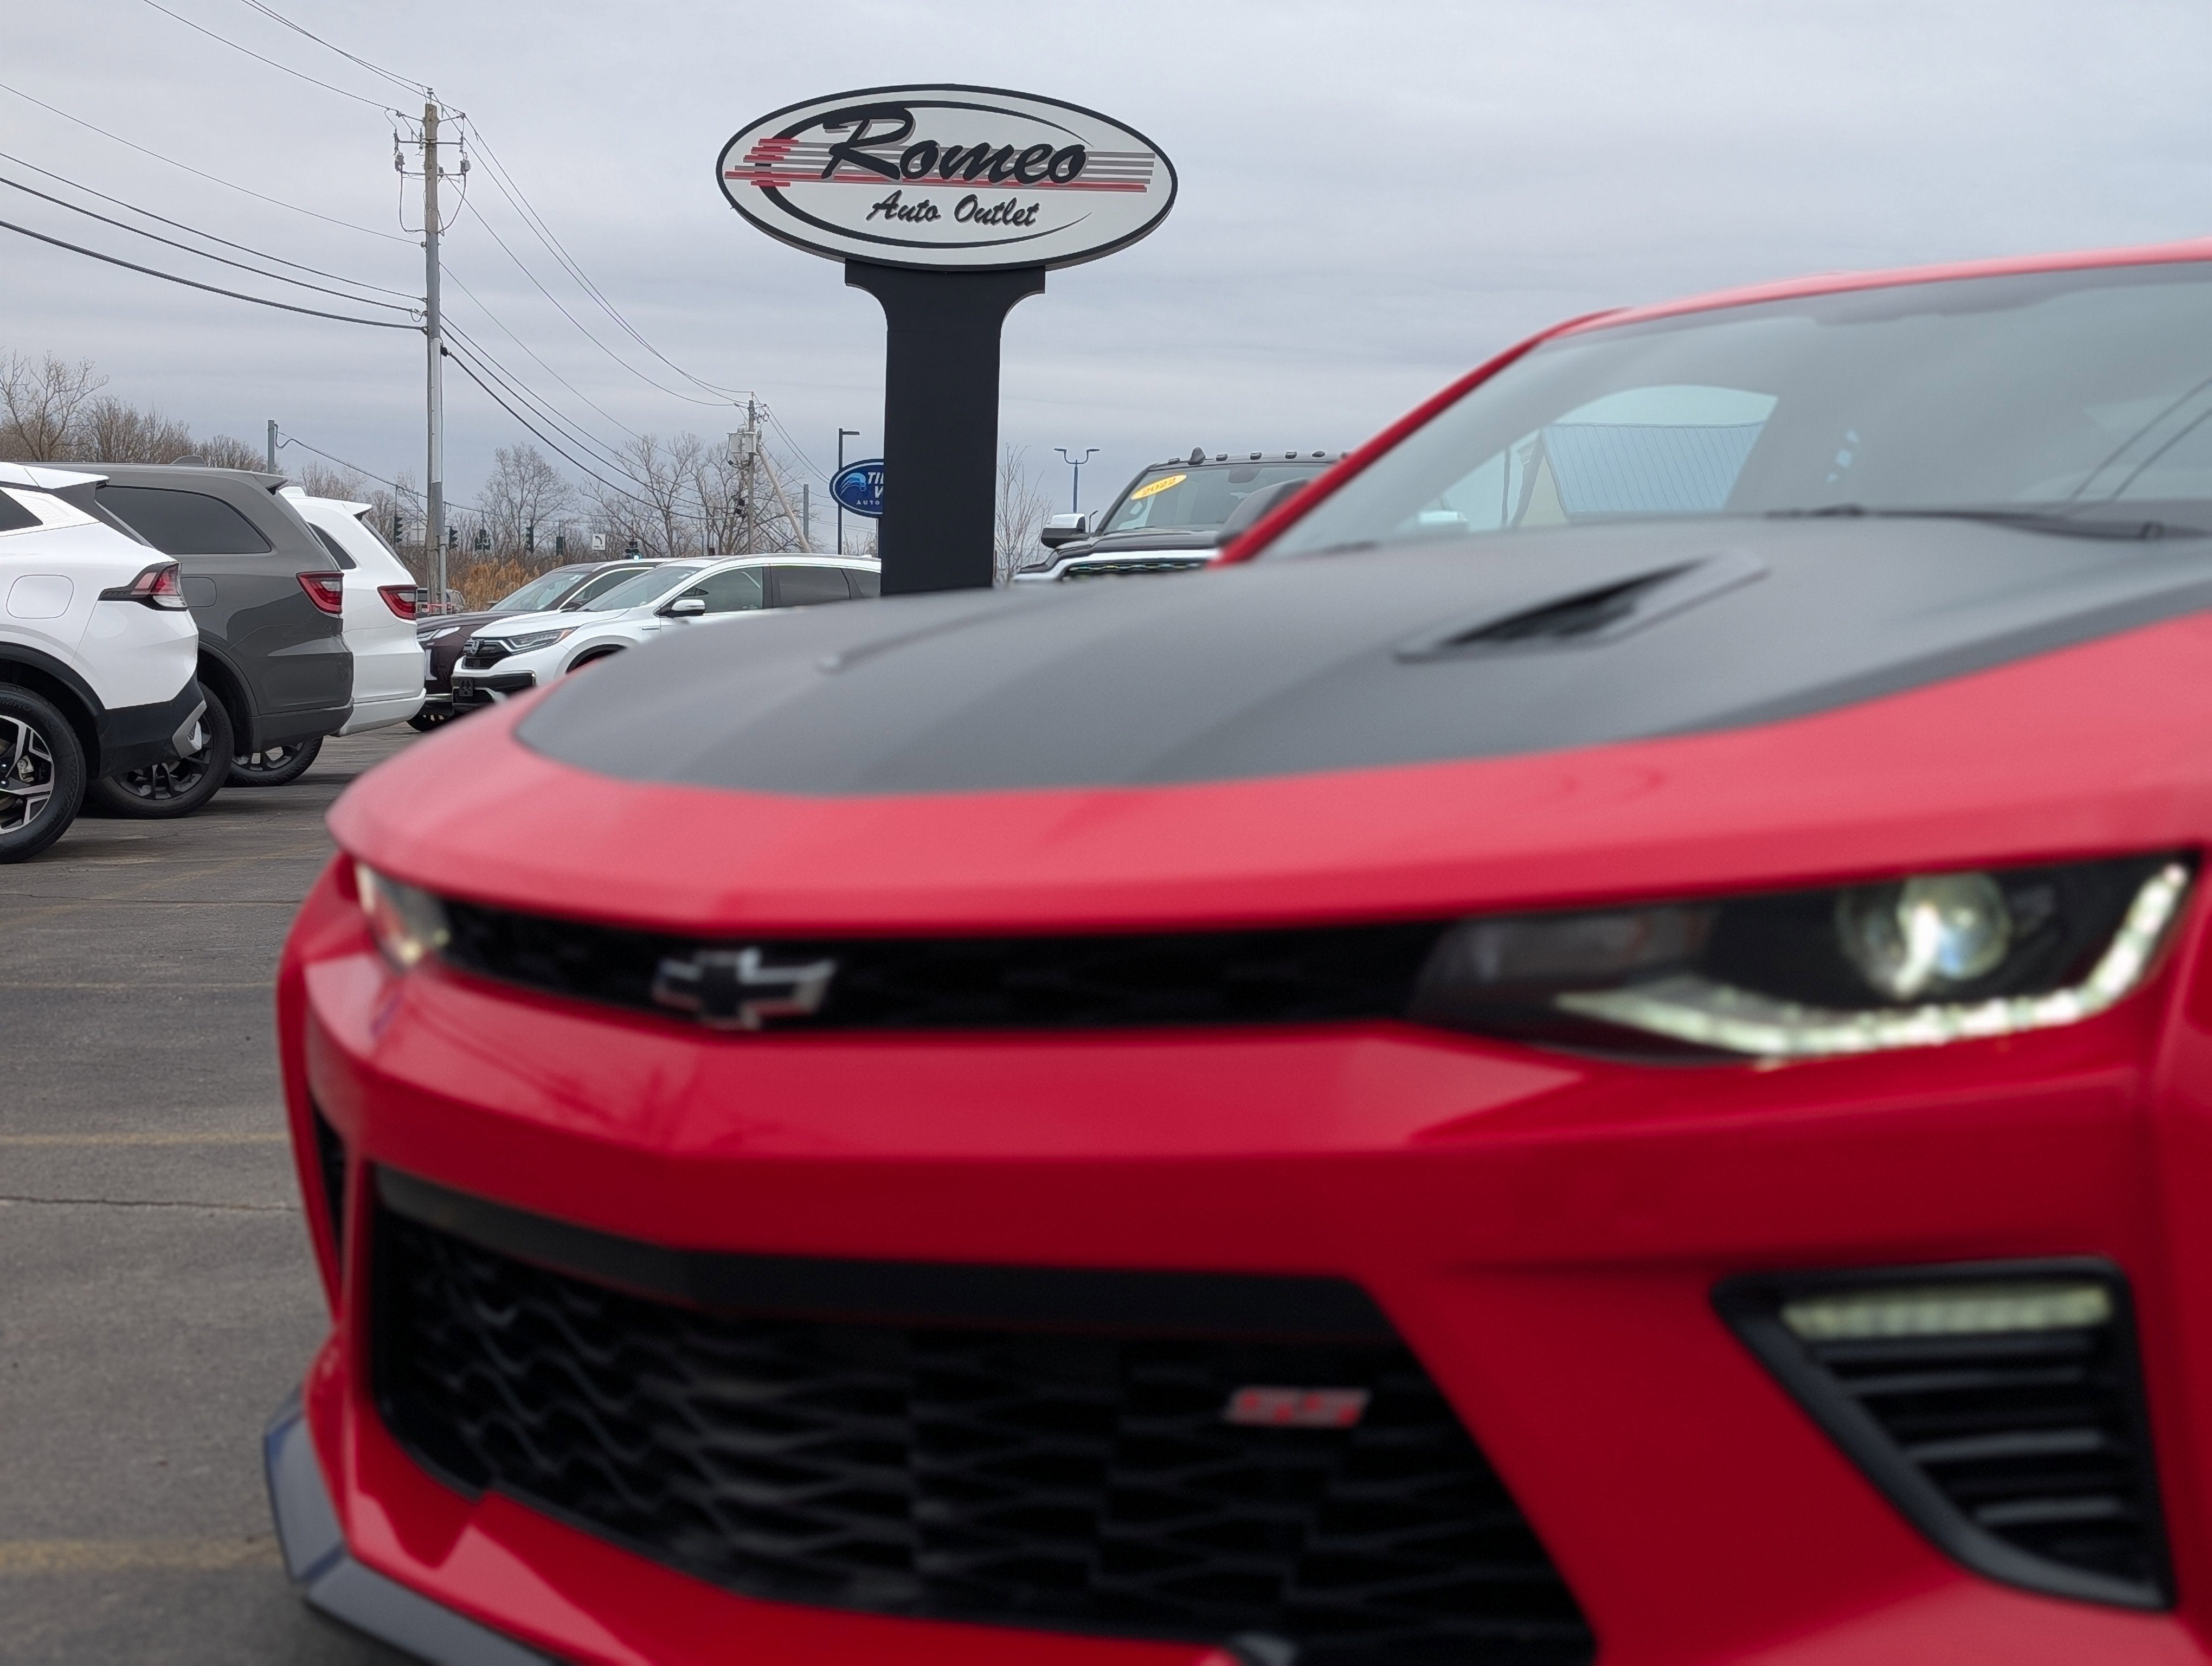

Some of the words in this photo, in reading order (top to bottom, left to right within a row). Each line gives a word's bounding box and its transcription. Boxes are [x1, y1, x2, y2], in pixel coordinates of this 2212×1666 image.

[821, 107, 1087, 184] Romeo
[866, 190, 942, 223] Auto
[954, 194, 1040, 227] Outlet
